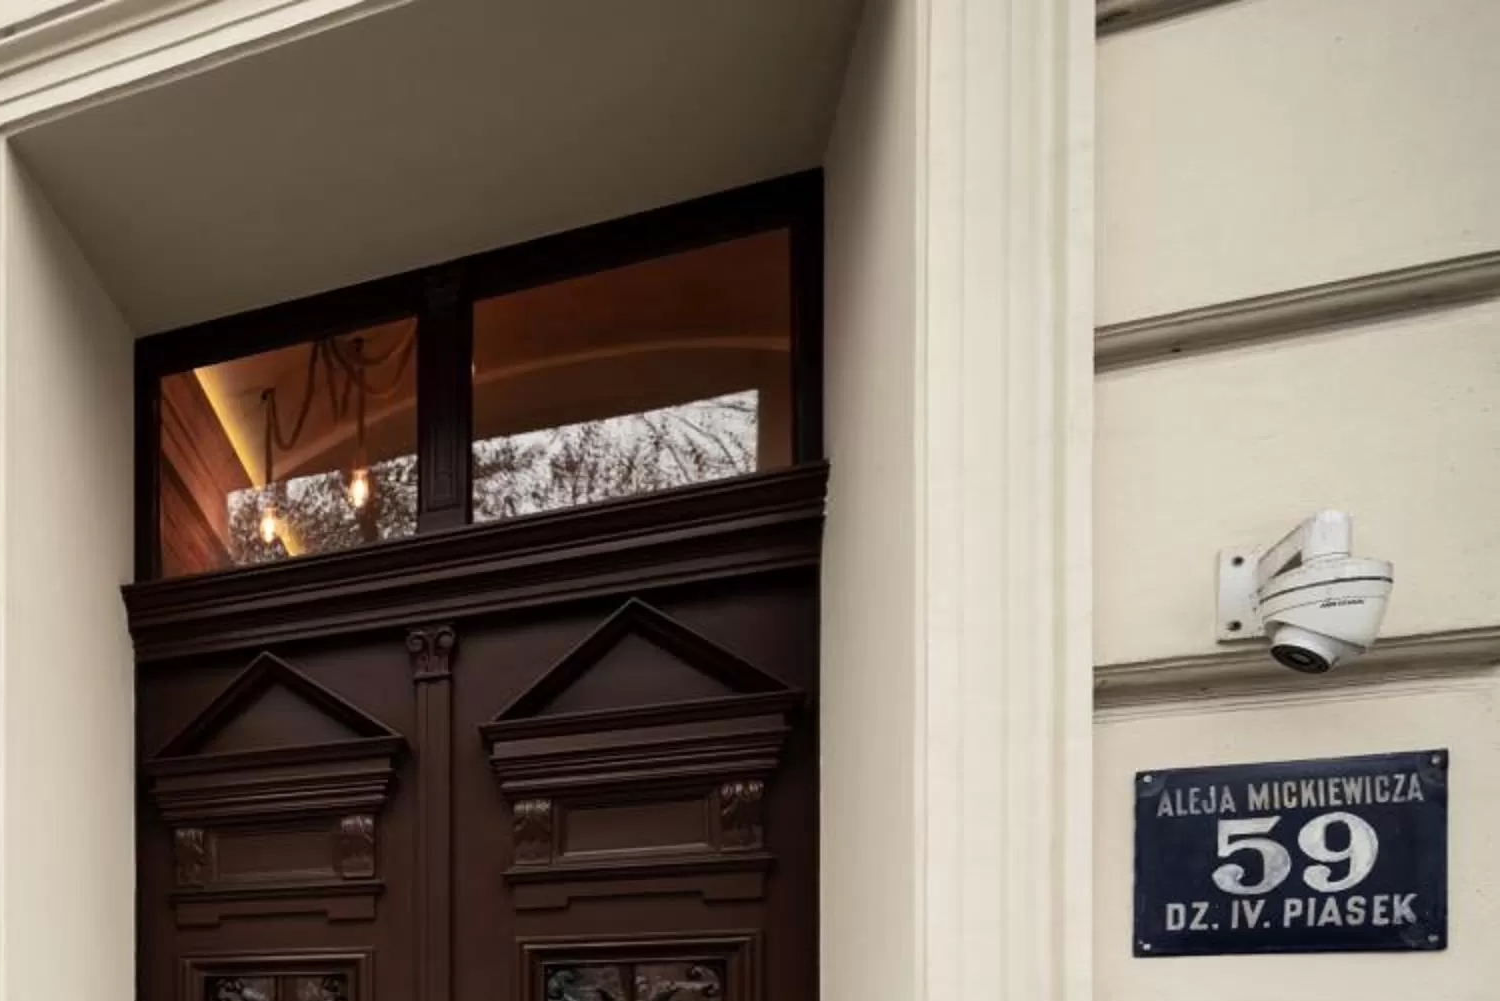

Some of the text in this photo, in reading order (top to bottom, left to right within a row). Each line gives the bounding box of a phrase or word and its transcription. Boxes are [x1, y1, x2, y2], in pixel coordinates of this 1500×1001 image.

[1156, 772, 1425, 817] ALEJA MICKIEWICZA
[1211, 811, 1379, 895] 59
[1165, 893, 1419, 931] DZ. IV. PIASEK
